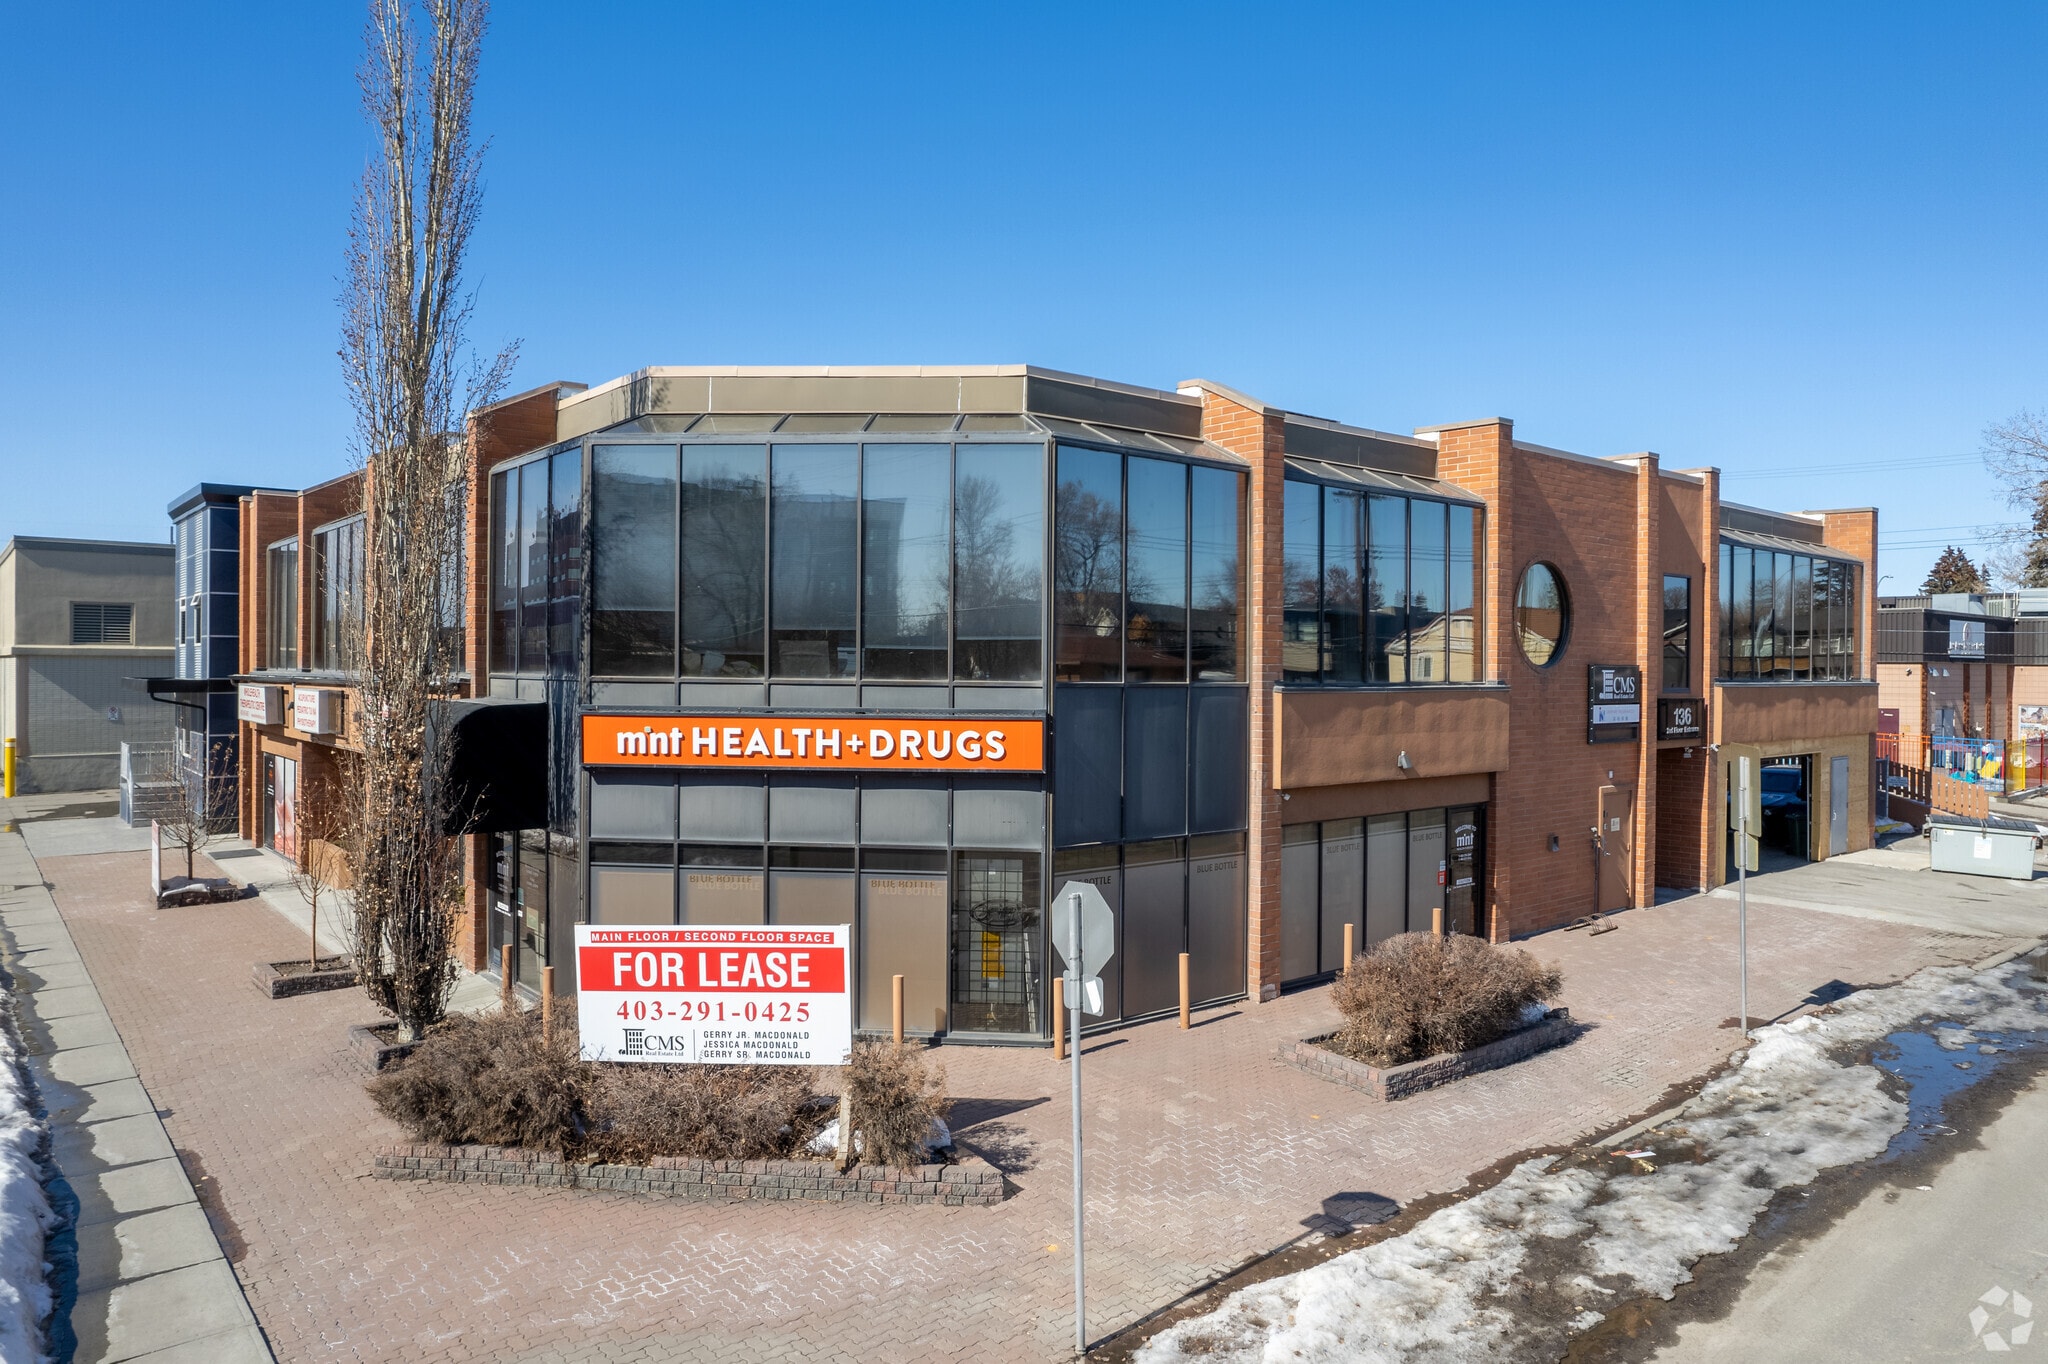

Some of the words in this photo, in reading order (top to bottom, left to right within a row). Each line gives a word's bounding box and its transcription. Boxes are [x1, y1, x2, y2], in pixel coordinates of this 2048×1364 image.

[1613, 676, 1635, 694] CMS
[1673, 707, 1692, 725] 136
[617, 726, 683, 755] mint
[692, 727, 1006, 760] HEALTH+DRUGS
[1426, 832, 1443, 841] BOTTLE
[1456, 833, 1475, 848] mint
[1341, 843, 1361, 852] BOTTLE
[1196, 863, 1213, 873] BLUE
[1214, 861, 1238, 871] BOTTLE
[591, 932, 622, 942] MAIN
[628, 932, 669, 941] FLOOR
[684, 932, 736, 941] SECOND
[741, 932, 784, 942] FLOOR
[789, 933, 831, 943] SPACE
[613, 951, 686, 988] FOR
[698, 951, 811, 989] LEASE
[616, 1000, 810, 1022] 403-291-0425
[703, 1030, 733, 1039] GERRY
[736, 1031, 751, 1039] JR.
[754, 1031, 810, 1040] MACDONALD
[644, 1034, 685, 1051] CMS
[703, 1040, 740, 1049] JESSICA
[743, 1041, 799, 1049] MACDONALD
[703, 1050, 733, 1059] GERRY
[755, 1050, 811, 1060] MACDONALD
